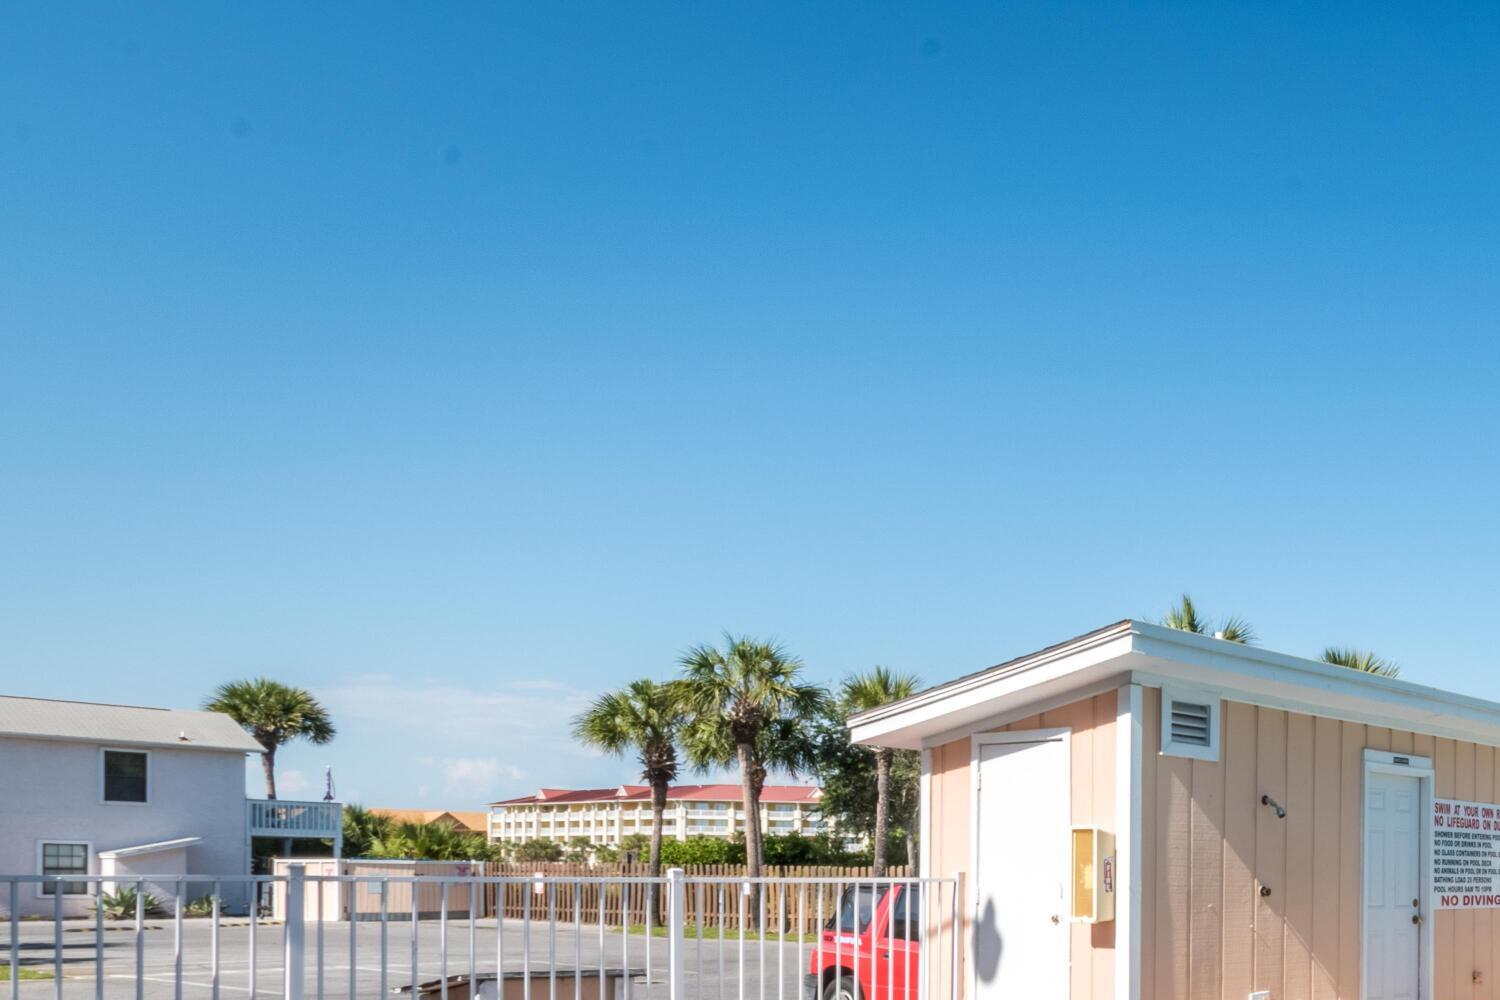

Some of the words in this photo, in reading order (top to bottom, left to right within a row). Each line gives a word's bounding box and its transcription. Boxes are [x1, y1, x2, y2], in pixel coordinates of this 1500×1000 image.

[1434, 802, 1450, 814] SWIM
[1454, 805, 1460, 815] AT
[1464, 806, 1478, 817] YOUR
[1482, 808, 1494, 818] OWN
[1434, 815, 1444, 826] NO
[1447, 816, 1479, 829] LIFEGUARD
[1483, 820, 1491, 831] ON
[1441, 895, 1459, 906] NO
